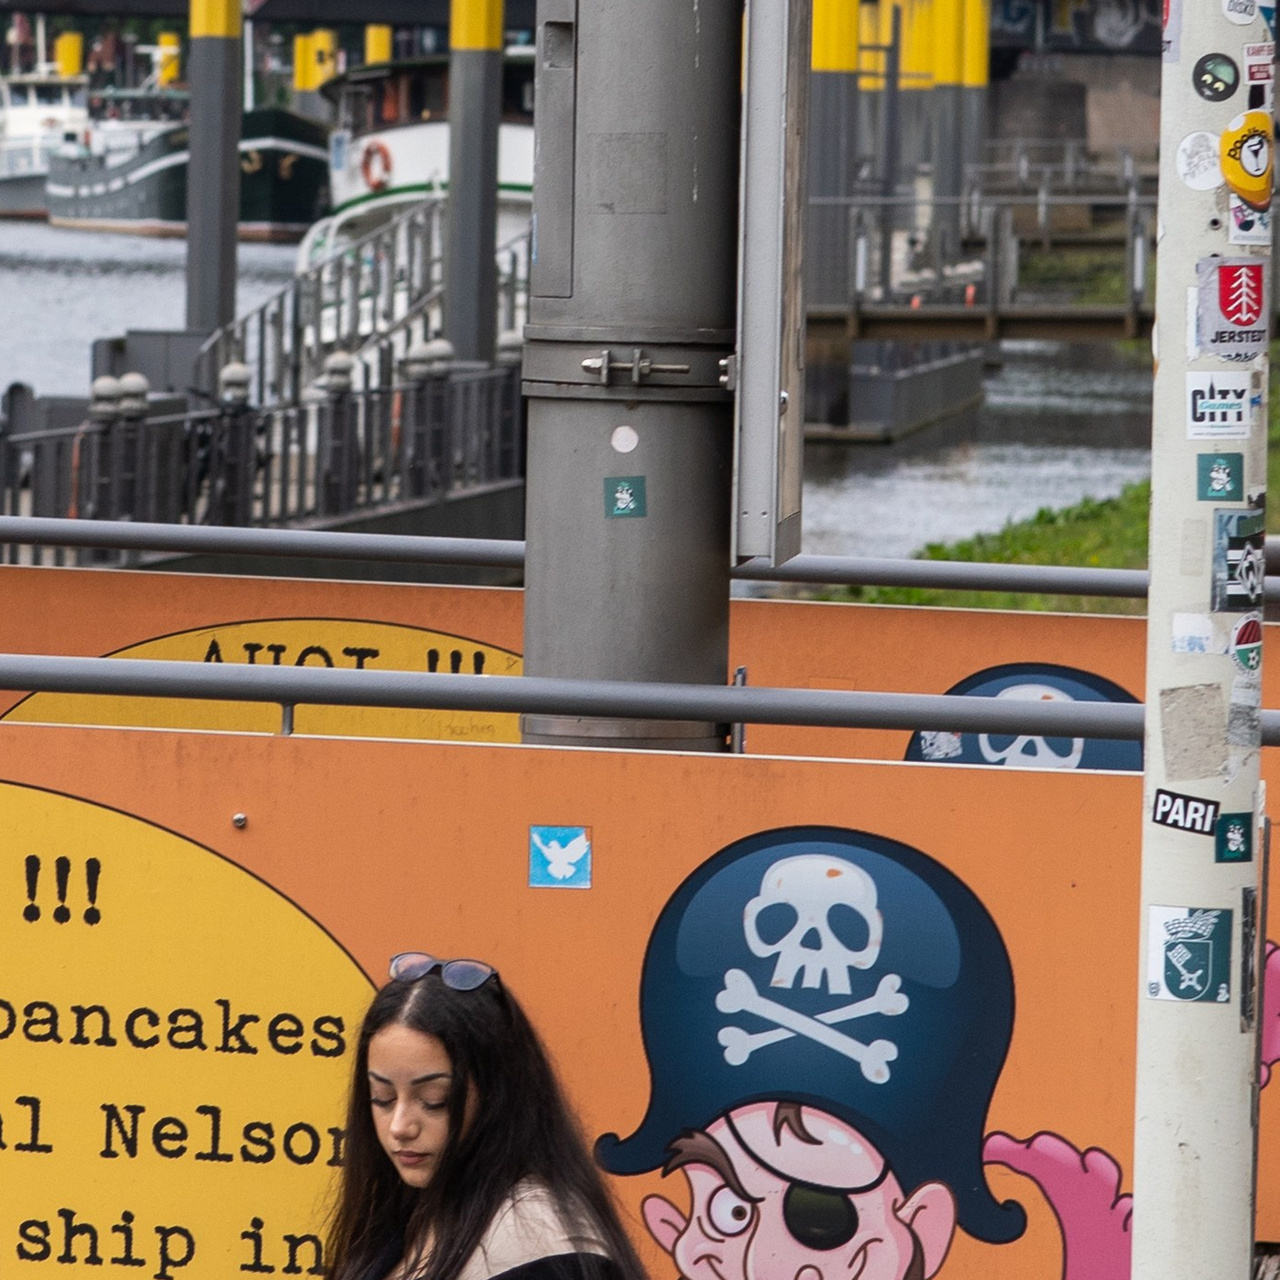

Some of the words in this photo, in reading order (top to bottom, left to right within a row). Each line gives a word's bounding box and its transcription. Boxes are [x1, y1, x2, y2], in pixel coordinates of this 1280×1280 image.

[1192, 375, 1248, 423] CITY
[1199, 400, 1244, 411] Games
[1155, 792, 1216, 833] PARI
[22, 854, 102, 926] !!!
[240, 1217, 325, 1276] in
